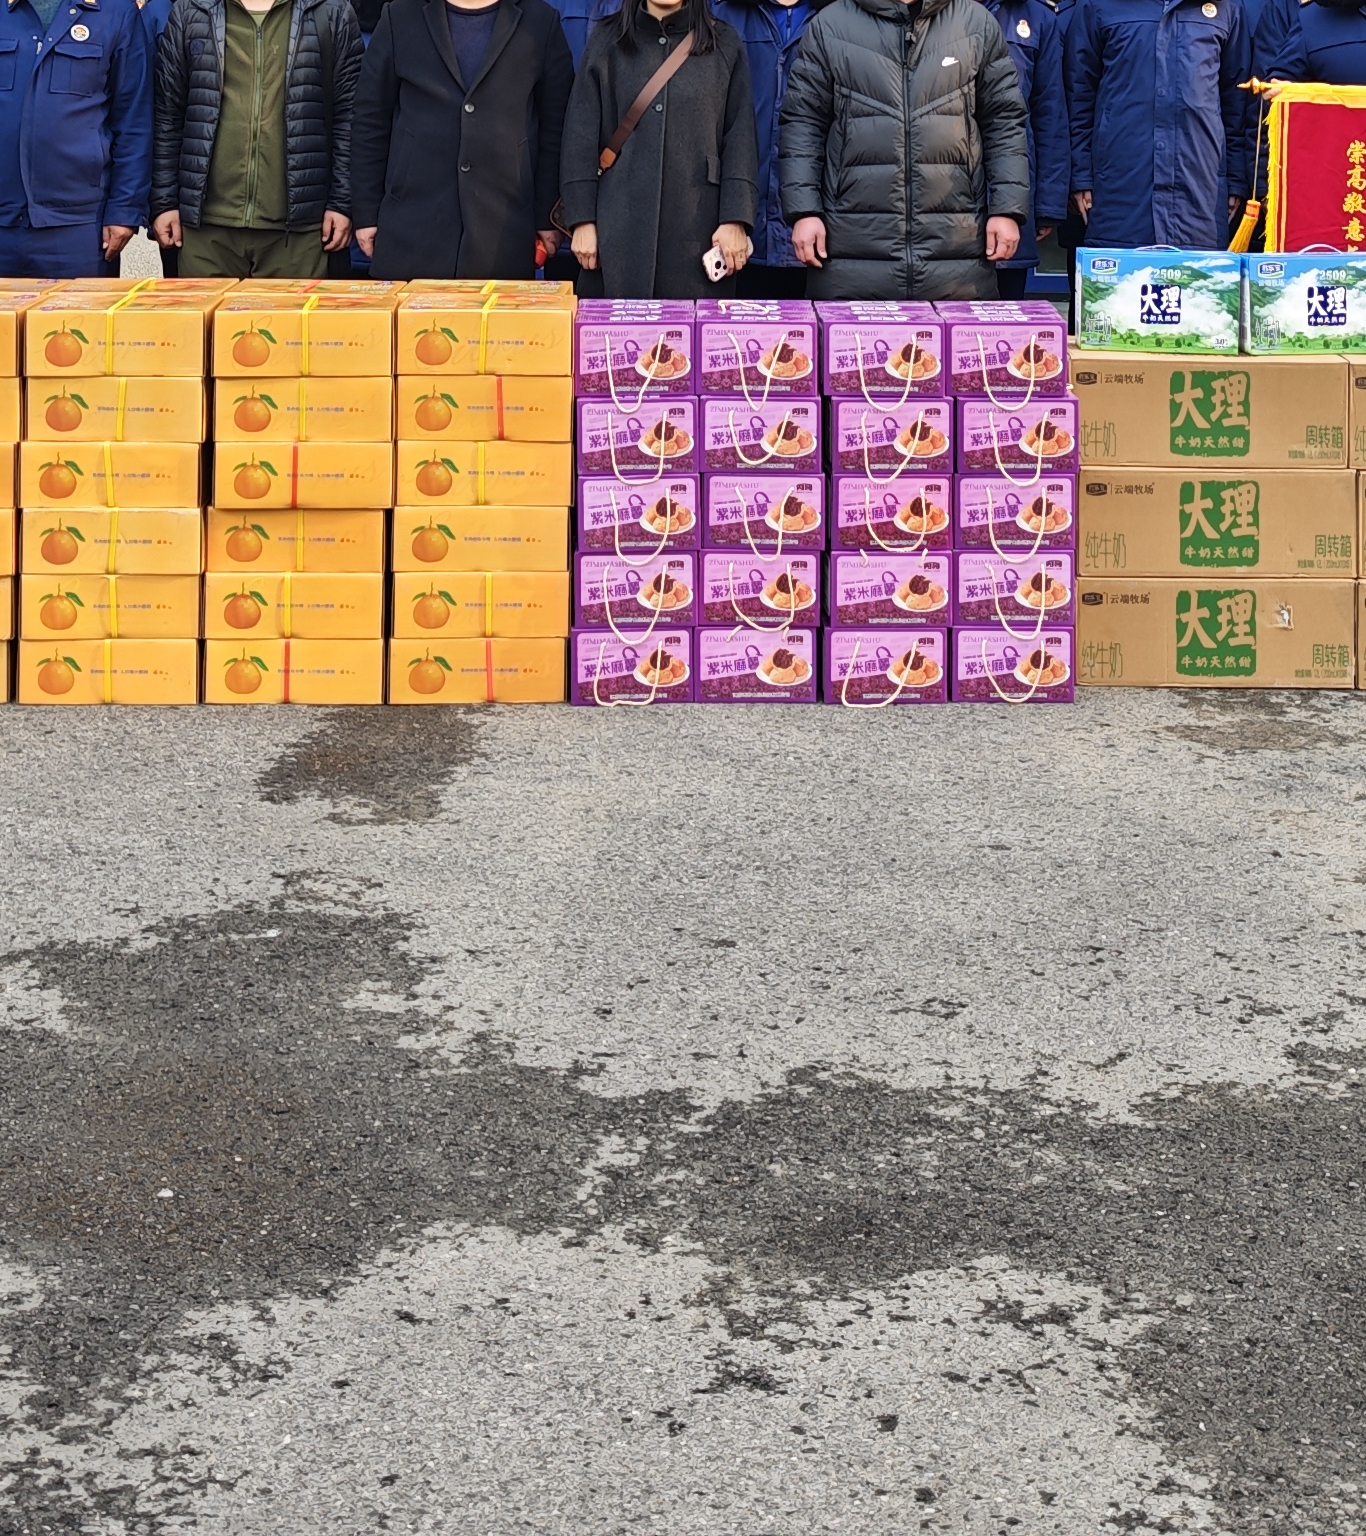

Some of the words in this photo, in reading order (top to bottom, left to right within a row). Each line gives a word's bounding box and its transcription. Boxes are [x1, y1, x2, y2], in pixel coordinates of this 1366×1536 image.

[1319, 270, 1346, 280] 2509
[1140, 283, 1181, 314] 大理
[1307, 286, 1347, 316] 大理
[1104, 373, 1144, 385] 云端牧场
[1171, 371, 1249, 429] 大理
[1174, 435, 1245, 449] 牛奶天然甜
[1304, 424, 1342, 449] 周转箱
[1113, 483, 1153, 495] 云端牧场
[1180, 481, 1258, 539] 大理
[1183, 545, 1254, 559] 牛奶天然甜
[1313, 534, 1351, 559] 周转箱
[1110, 592, 1150, 604] 云端牧场
[1177, 590, 1255, 648] 大理
[1180, 654, 1251, 668] 牛奶天然甜
[1310, 643, 1348, 668] 周转箱
